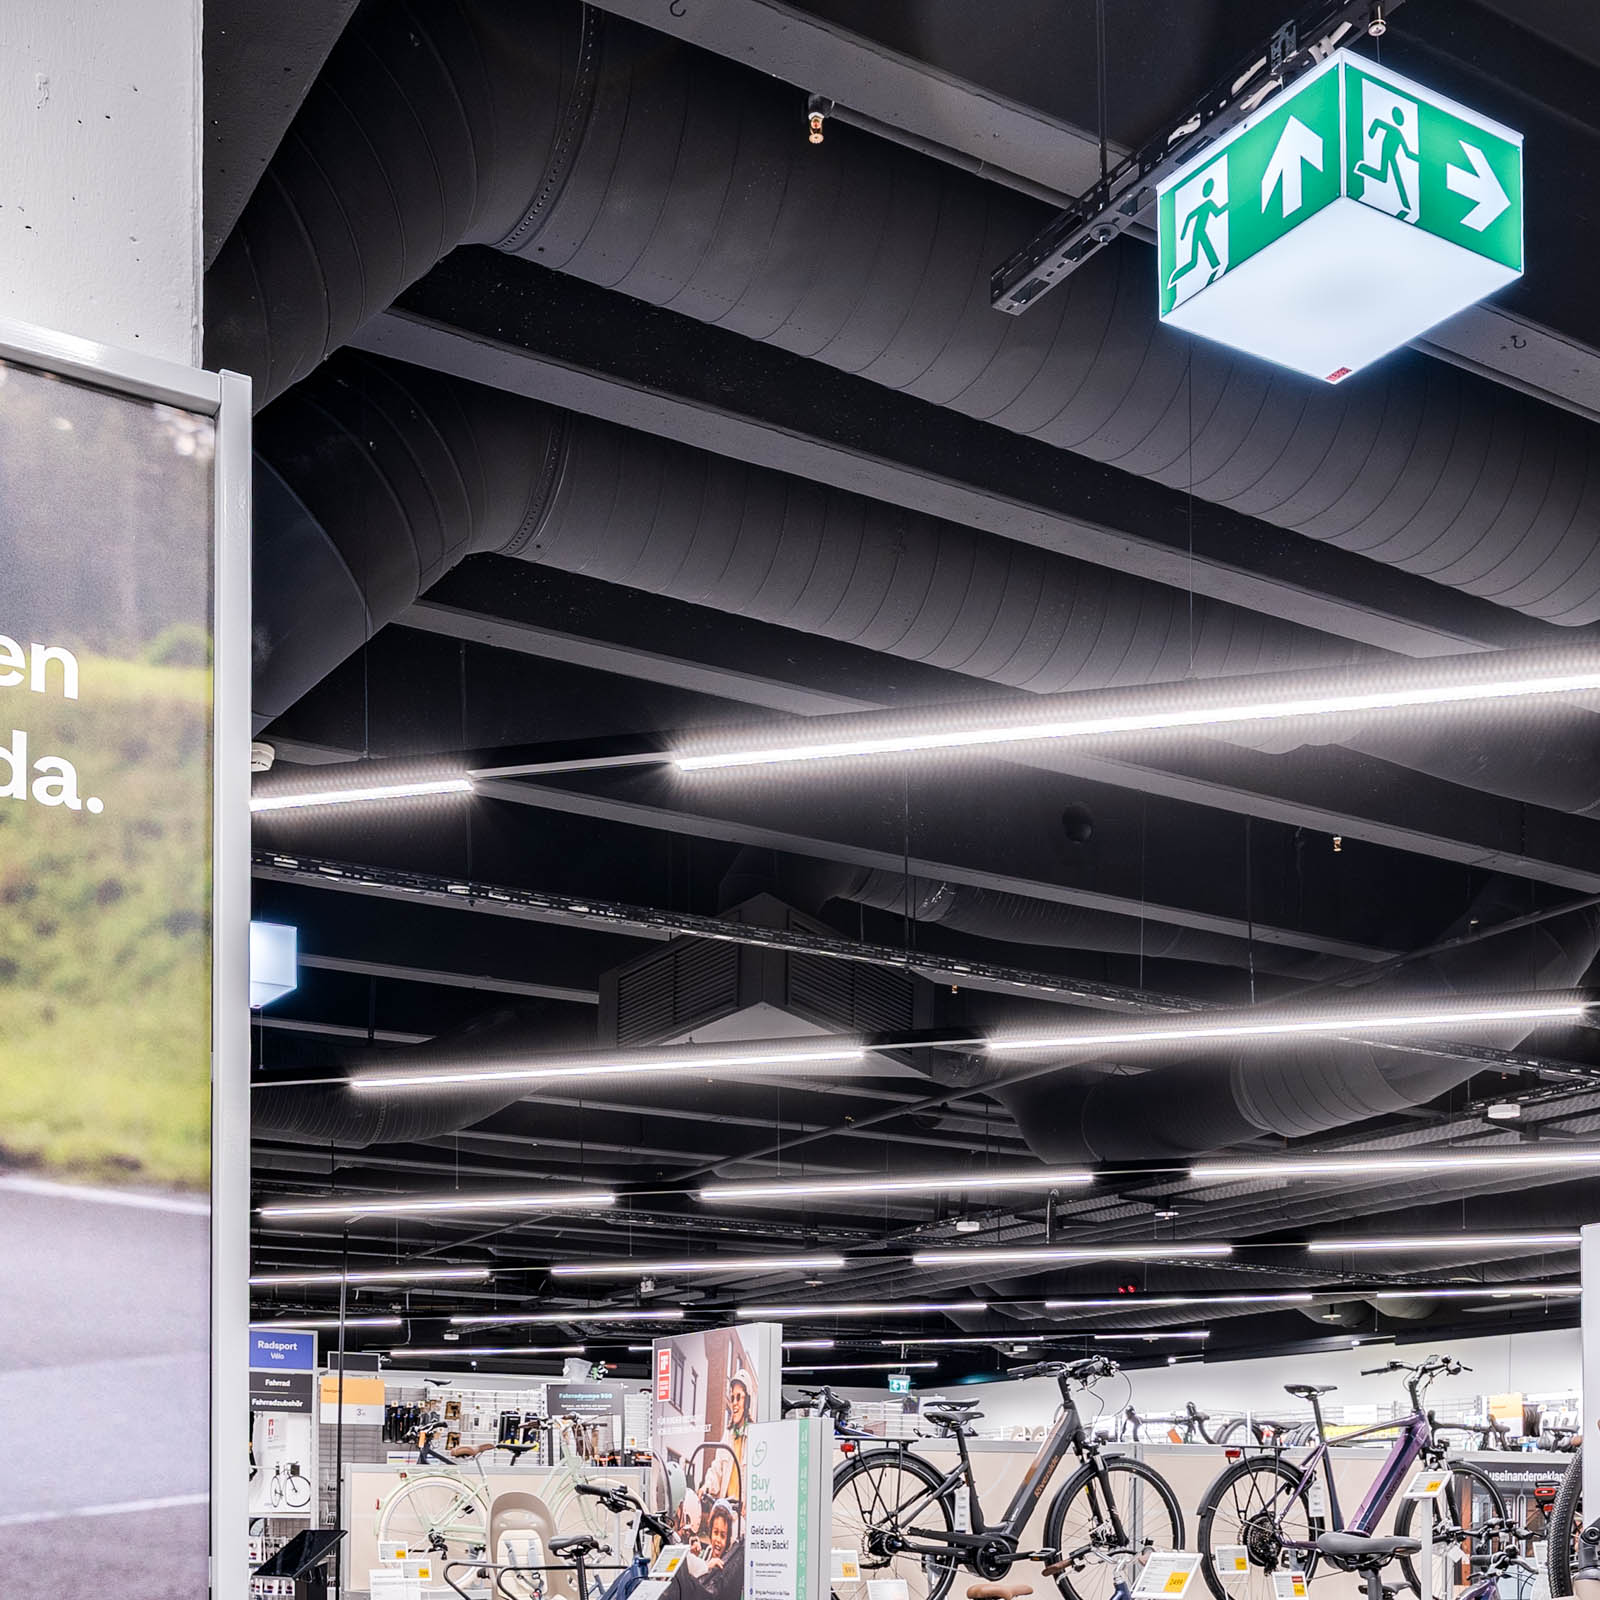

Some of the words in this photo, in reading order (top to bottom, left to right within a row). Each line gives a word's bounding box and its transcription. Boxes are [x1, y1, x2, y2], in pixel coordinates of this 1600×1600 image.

[258, 1340, 297, 1351] Radsport
[264, 1379, 291, 1387] Fahrrad
[751, 1474, 770, 1493] Buy
[1034, 1455, 1060, 1497] Riverside
[750, 1495, 775, 1512] Back
